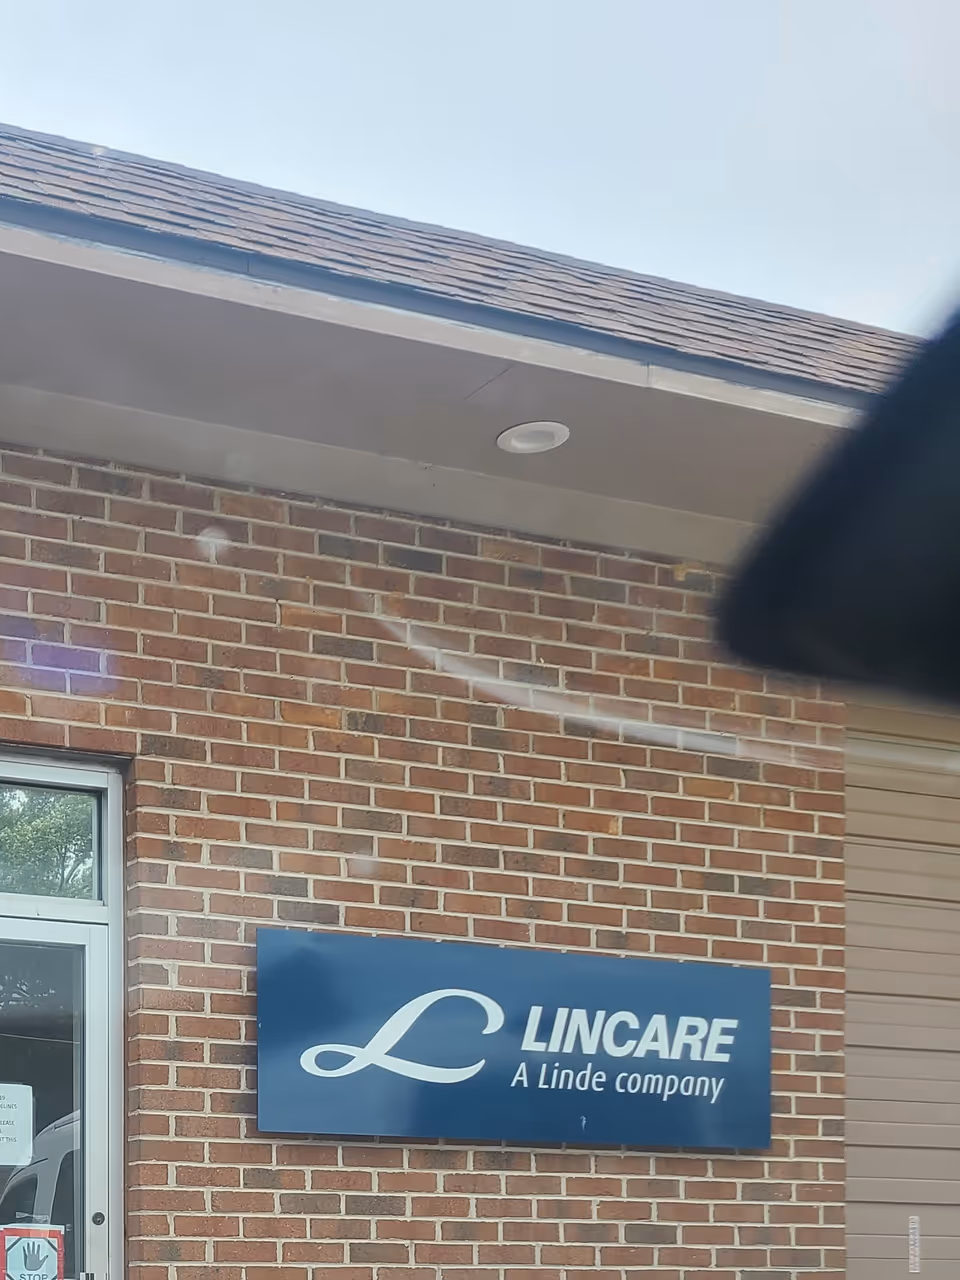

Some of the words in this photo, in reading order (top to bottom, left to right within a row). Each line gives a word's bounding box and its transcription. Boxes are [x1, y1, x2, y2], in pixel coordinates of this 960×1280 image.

[520, 1005, 739, 1063] LINCARE
[510, 1063, 530, 1089] A
[538, 1063, 605, 1092] Linde
[615, 1070, 725, 1104] company
